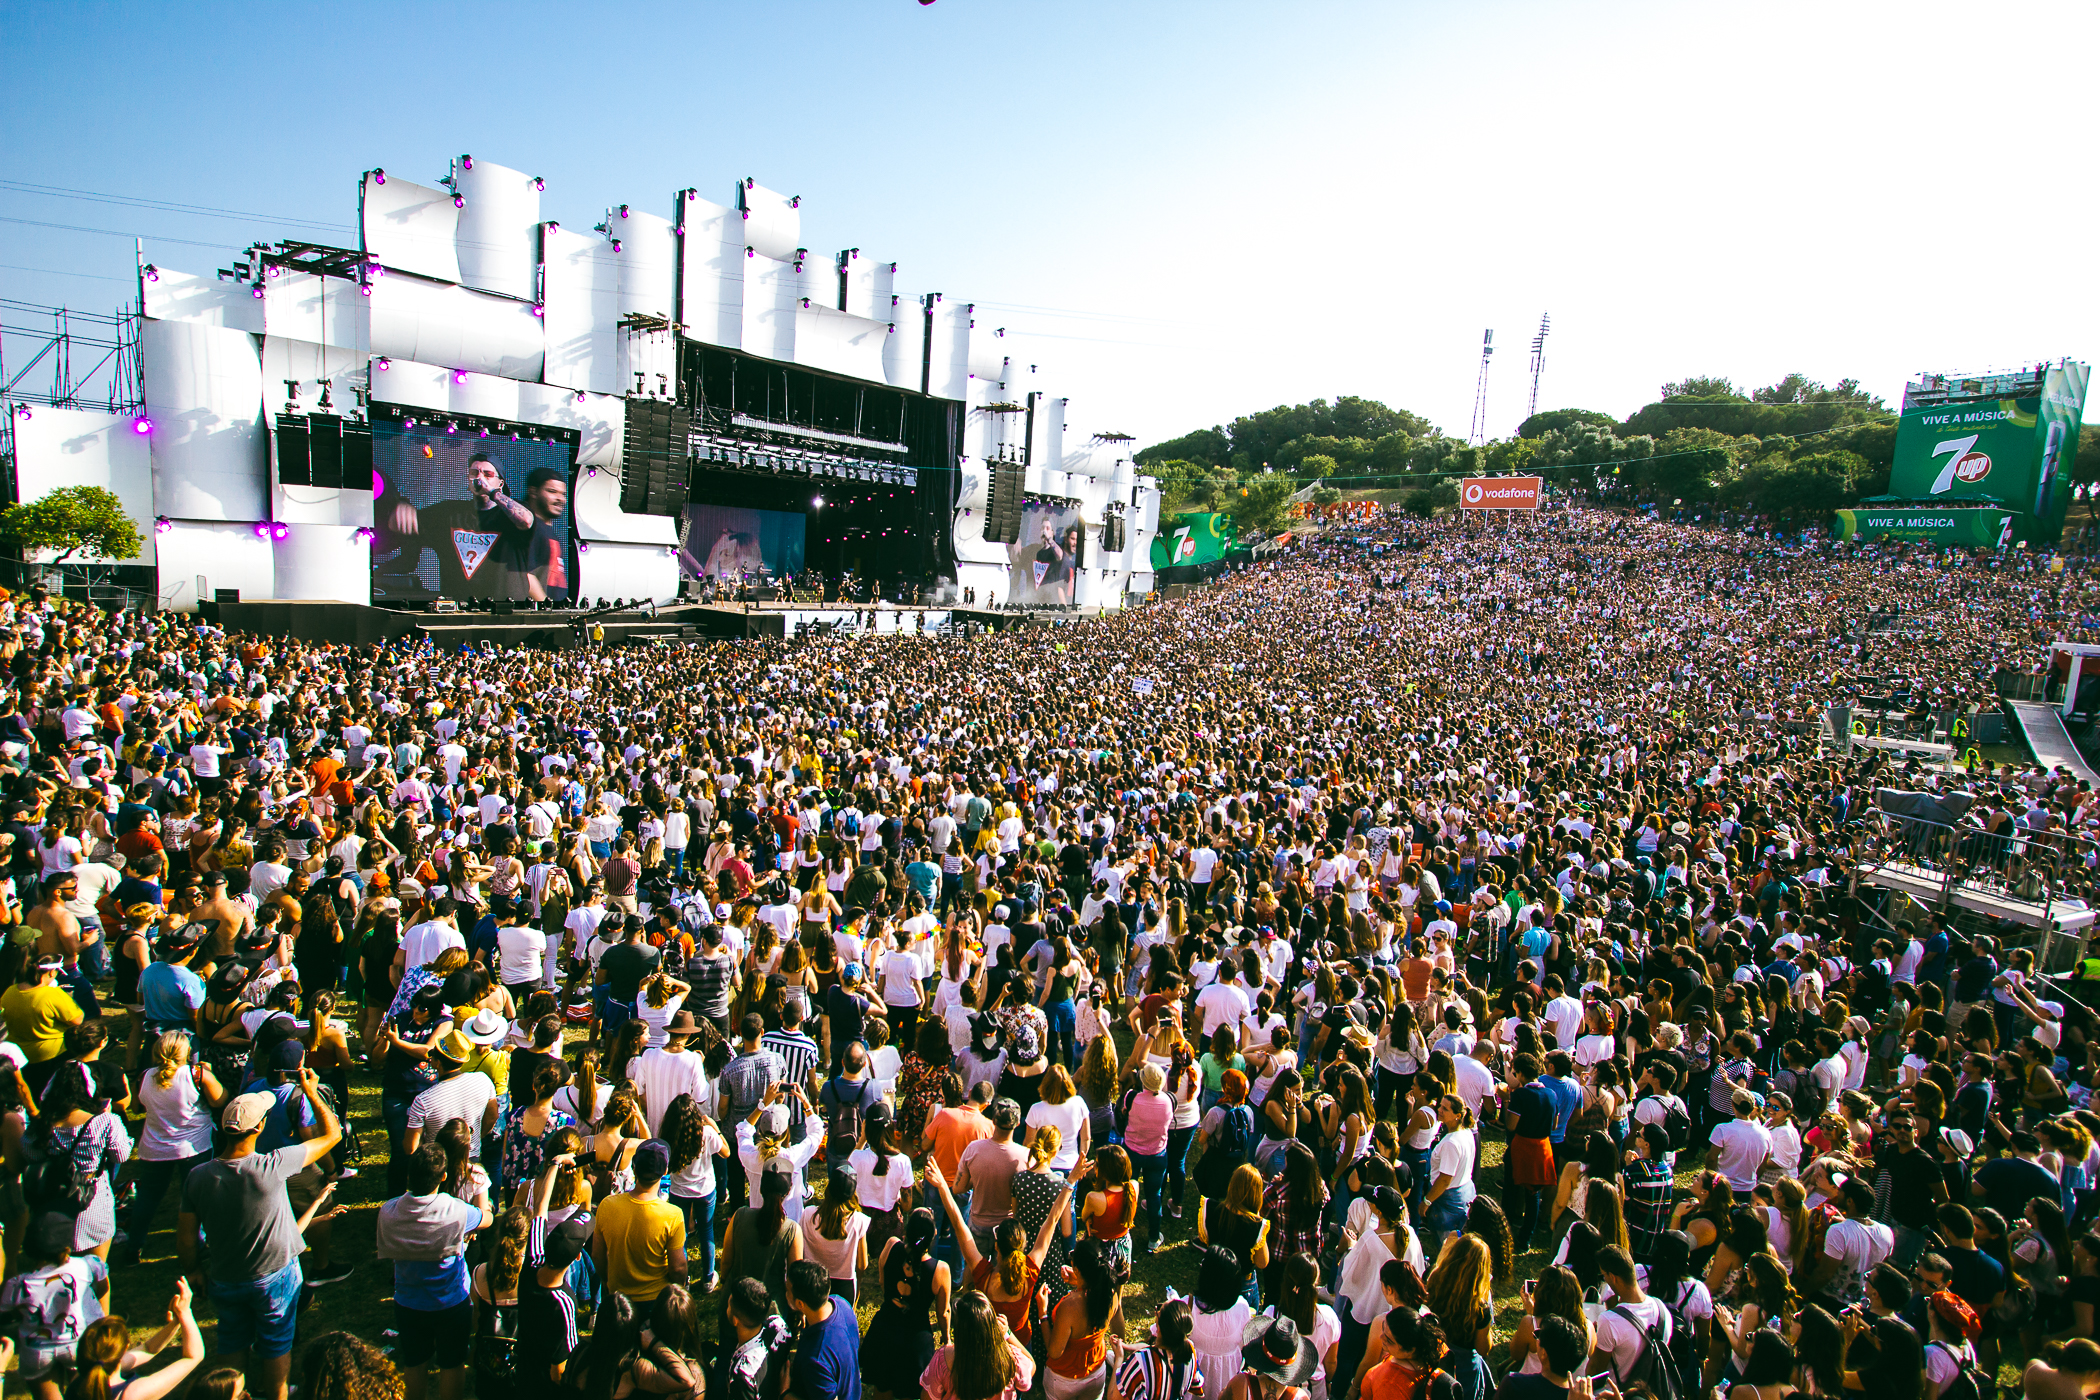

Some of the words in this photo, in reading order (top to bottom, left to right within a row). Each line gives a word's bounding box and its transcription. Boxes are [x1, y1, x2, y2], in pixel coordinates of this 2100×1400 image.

[1922, 415, 1950, 425] VIVE
[1952, 414, 1961, 423] A
[1964, 410, 2016, 422] MÚSICA
[1485, 488, 1535, 498] vodafone
[1868, 518, 1893, 527] VIVE
[1896, 518, 1904, 527] A
[1907, 516, 1955, 527] MÚSICA
[455, 532, 491, 546] GUESS
